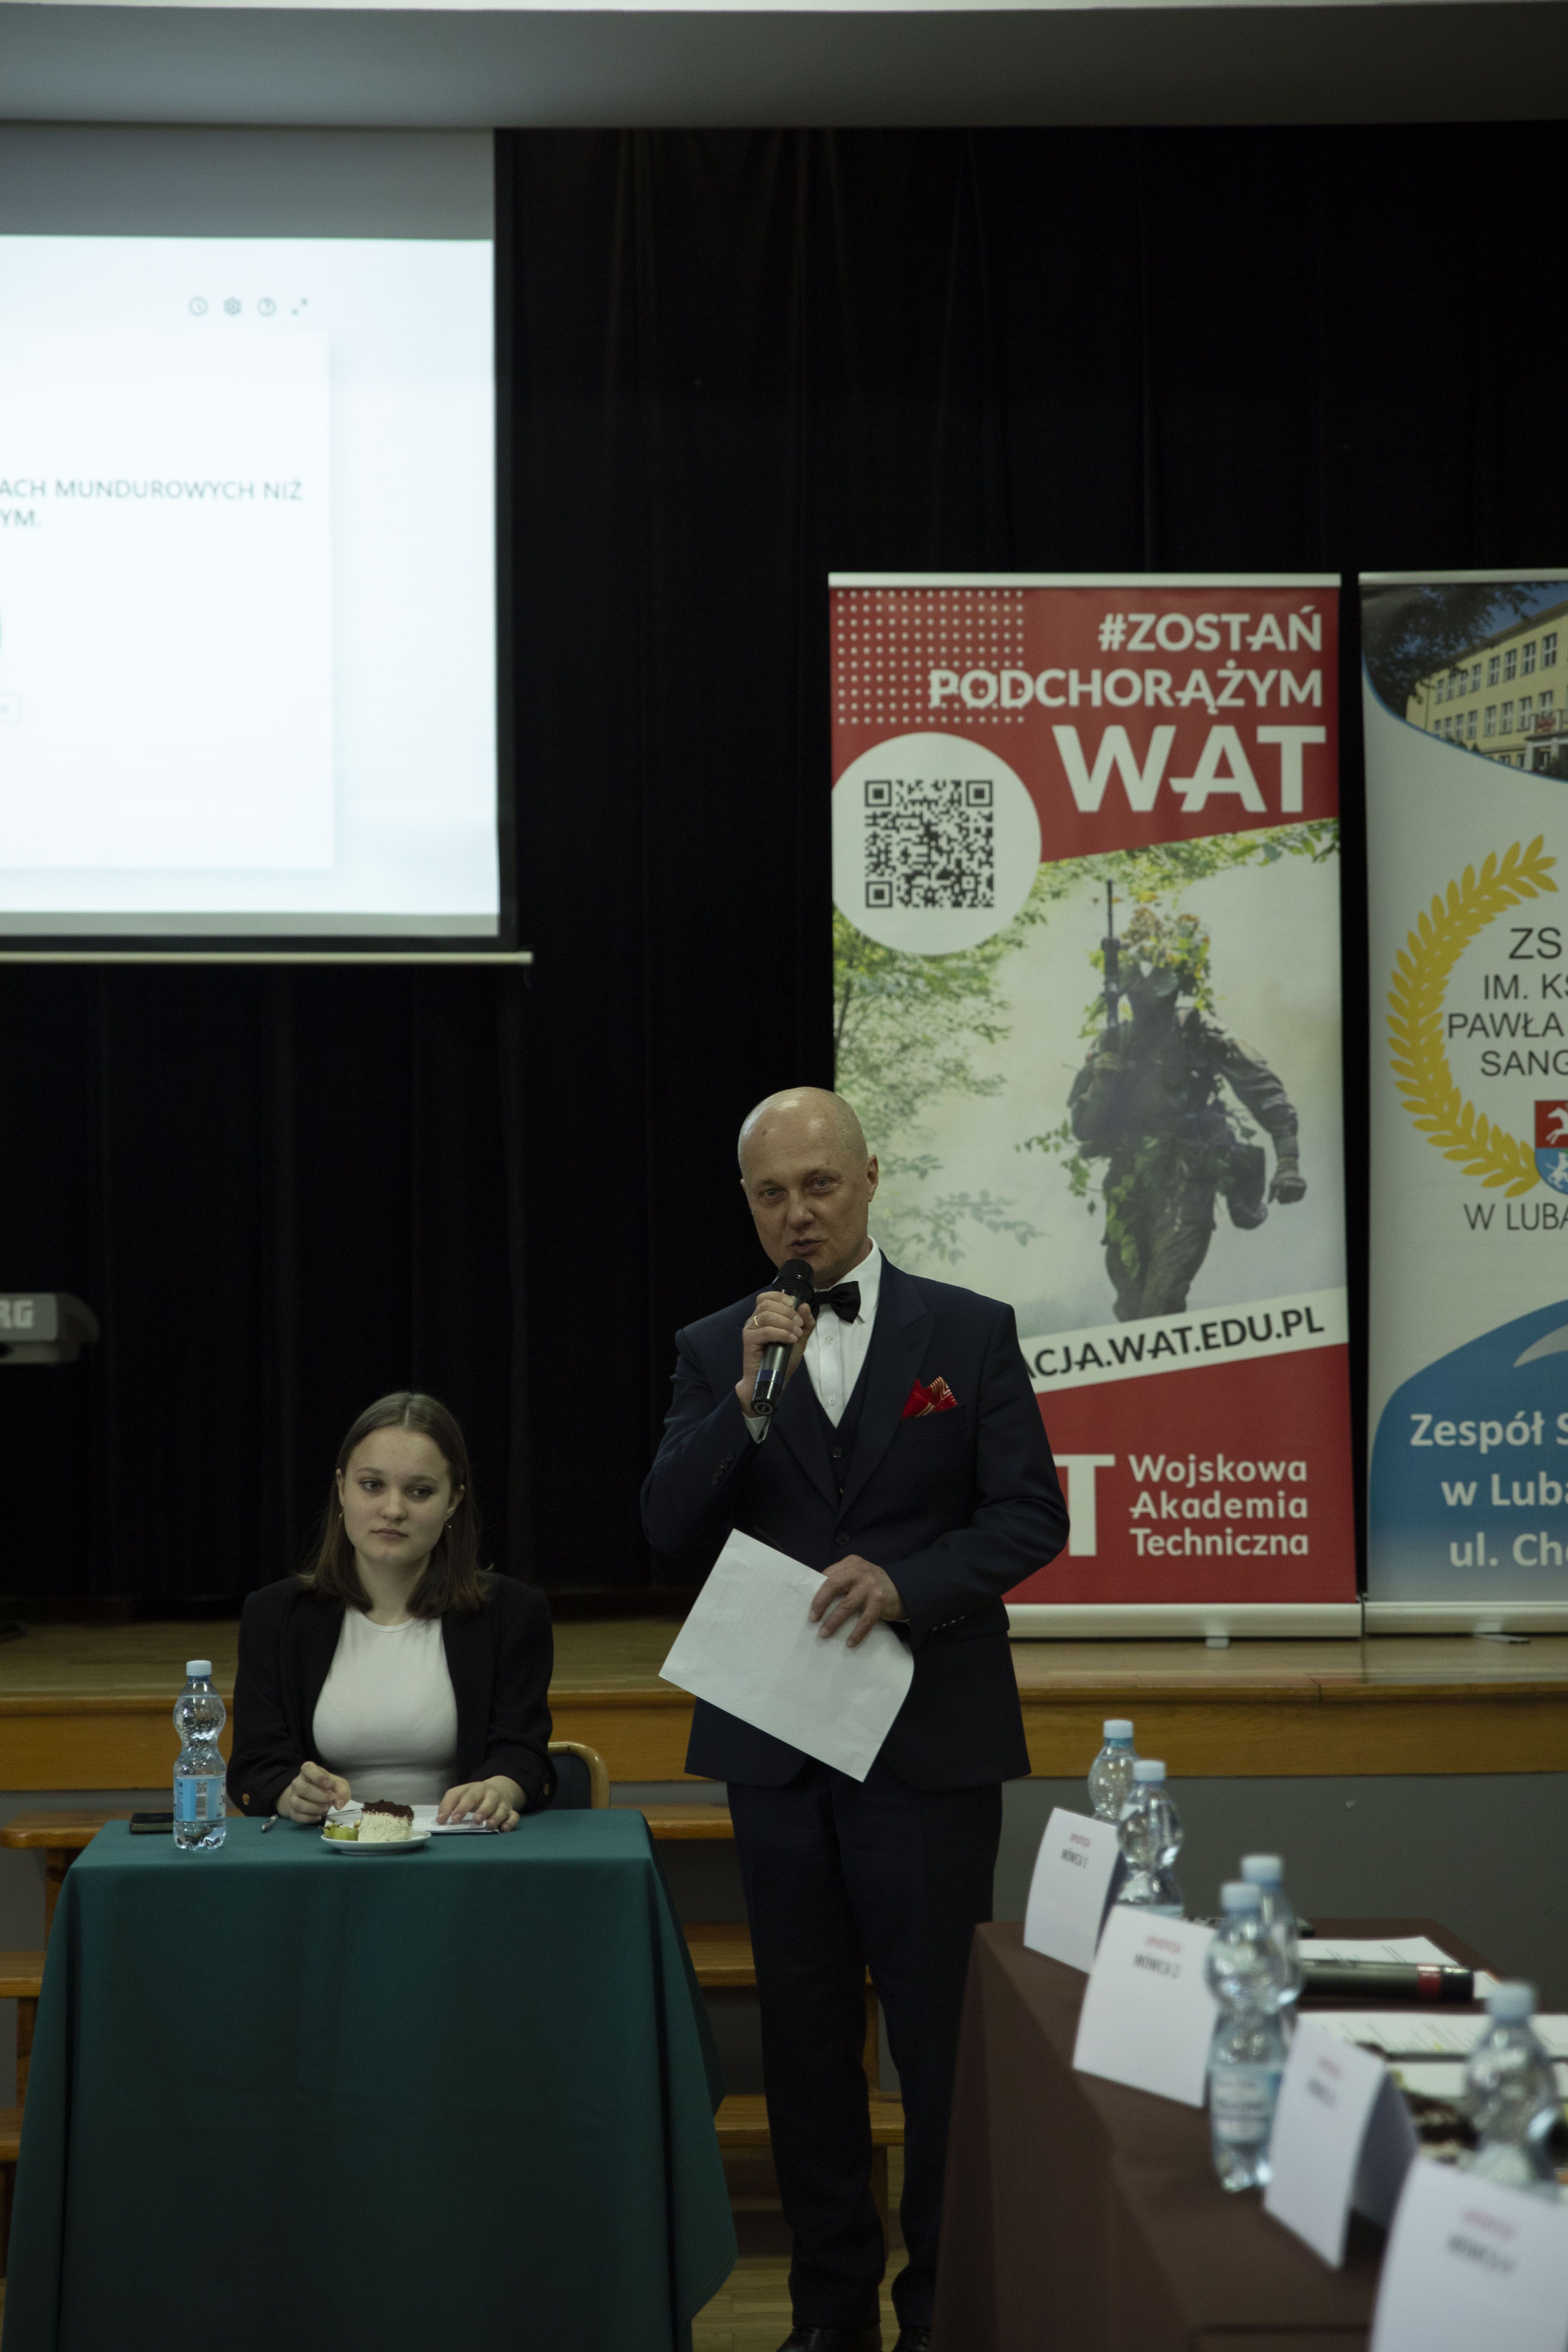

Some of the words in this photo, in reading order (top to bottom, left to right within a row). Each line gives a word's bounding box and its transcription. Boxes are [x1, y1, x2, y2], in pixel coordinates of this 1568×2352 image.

[55, 479, 254, 500] MUNDUROWYCH
[263, 477, 303, 500] NIŻ
[1097, 605, 1322, 652] #ZOSTAŃ
[929, 660, 1322, 715] PODCHORĄŻYM
[1051, 724, 1325, 813] WAT
[1508, 926, 1562, 960] ZS
[1484, 974, 1528, 1000] IM.
[1541, 973, 1568, 999] K
[1448, 1011, 1565, 1039] PAWŁA
[1463, 1203, 1496, 1231] W
[1410, 1410, 1545, 1454] Zespół
[1128, 1453, 1307, 1488] Wojskowa
[1129, 1490, 1308, 1519] Akademia
[1441, 1481, 1478, 1507] w
[1491, 1471, 1568, 1507] Lub
[1129, 1527, 1309, 1556] Techniczna
[1449, 1531, 1499, 1568] ul.
[1512, 1531, 1568, 1568] Ch
